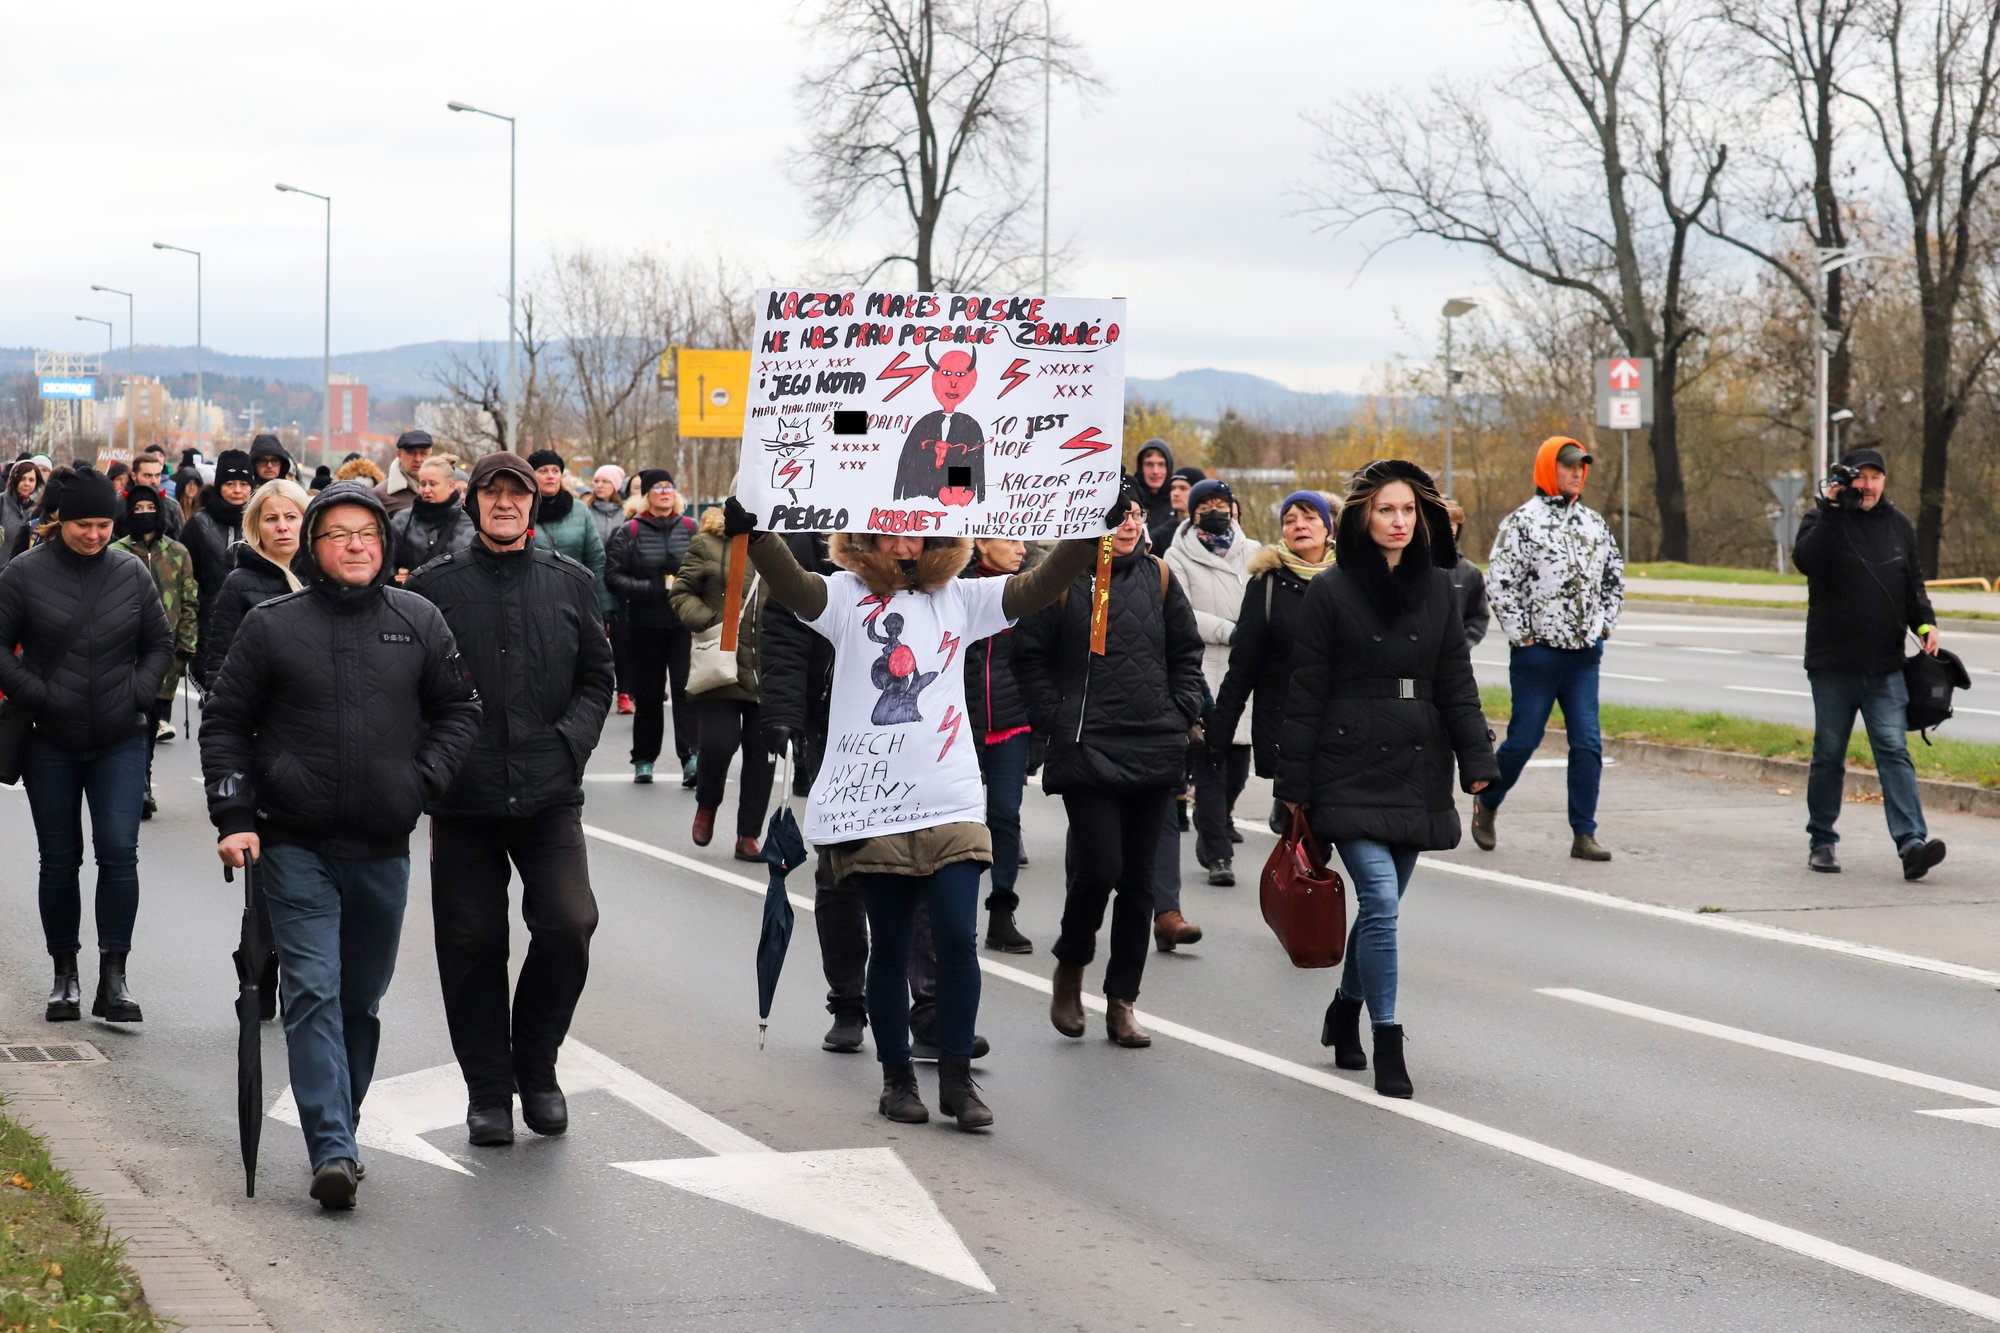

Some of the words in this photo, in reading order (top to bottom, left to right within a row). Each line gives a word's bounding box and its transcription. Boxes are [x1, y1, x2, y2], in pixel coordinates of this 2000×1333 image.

[767, 291, 855, 320] KACZOR
[866, 292, 940, 318] MIAŁEŚ
[801, 325, 839, 350] NAS
[844, 322, 894, 348] PRAW
[898, 323, 999, 346] POZBAWIĆ
[768, 373, 812, 401] JEGO
[815, 370, 867, 395] KOTA
[991, 416, 1018, 436] TO
[1025, 414, 1069, 440] JEST
[993, 441, 1035, 459] MOJE
[1001, 472, 1071, 493] KACZOR
[1066, 489, 1098, 507] JAK
[867, 507, 949, 534] KOBIET
[1030, 524, 1048, 537] TO
[836, 732, 906, 756] NIECH
[817, 781, 917, 806] SYRENY
